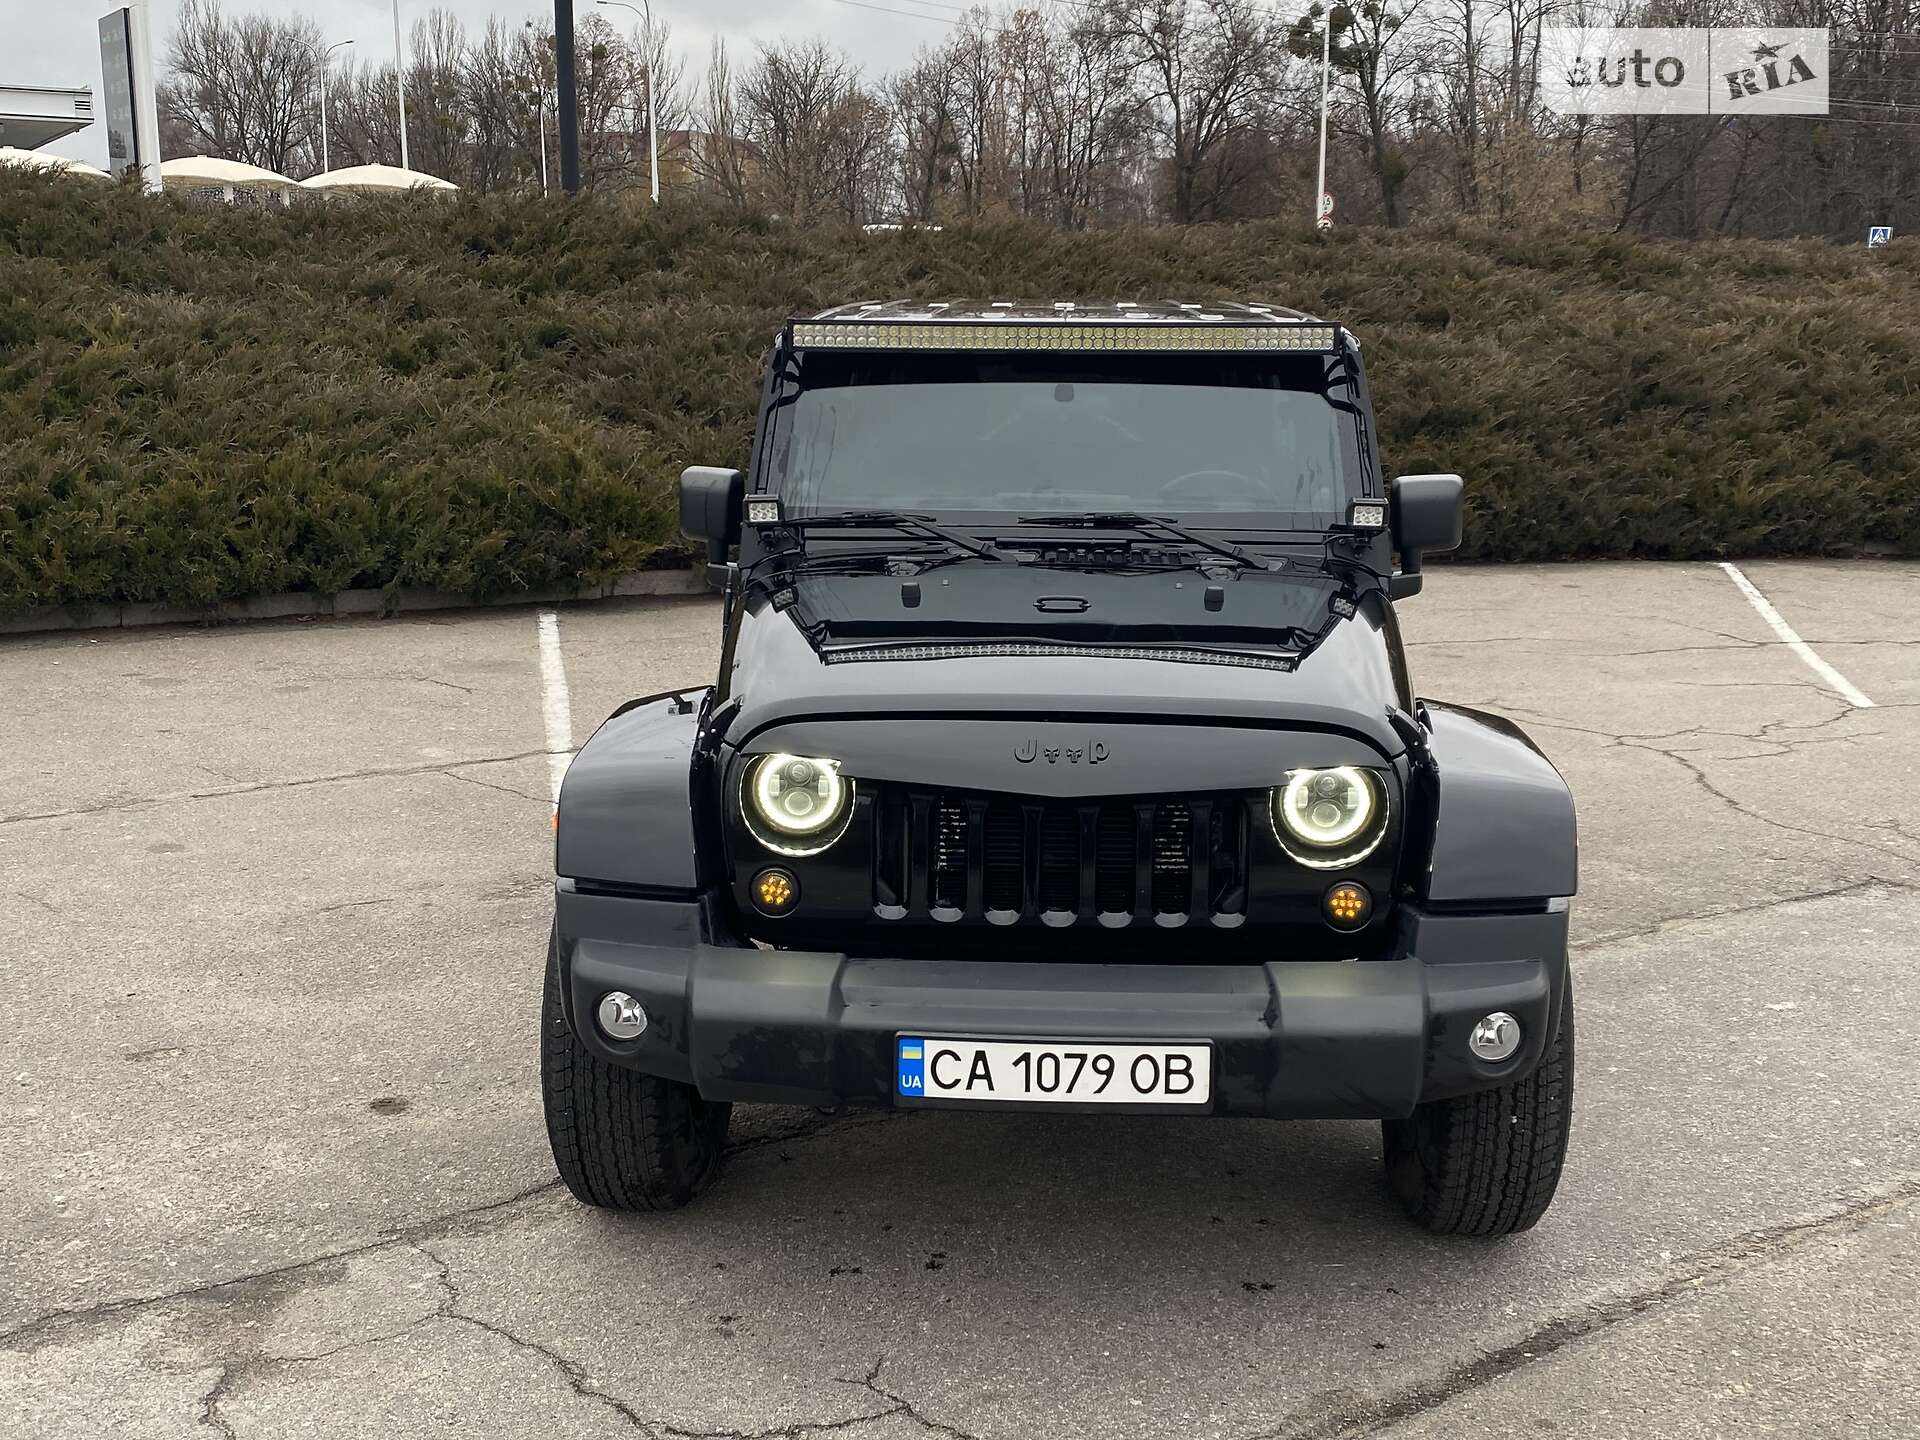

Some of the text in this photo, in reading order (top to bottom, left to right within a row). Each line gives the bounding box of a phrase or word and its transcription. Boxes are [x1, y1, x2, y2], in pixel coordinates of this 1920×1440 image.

[902, 1075, 922, 1088] UA
[930, 1049, 1194, 1094] CA 1079 OB
